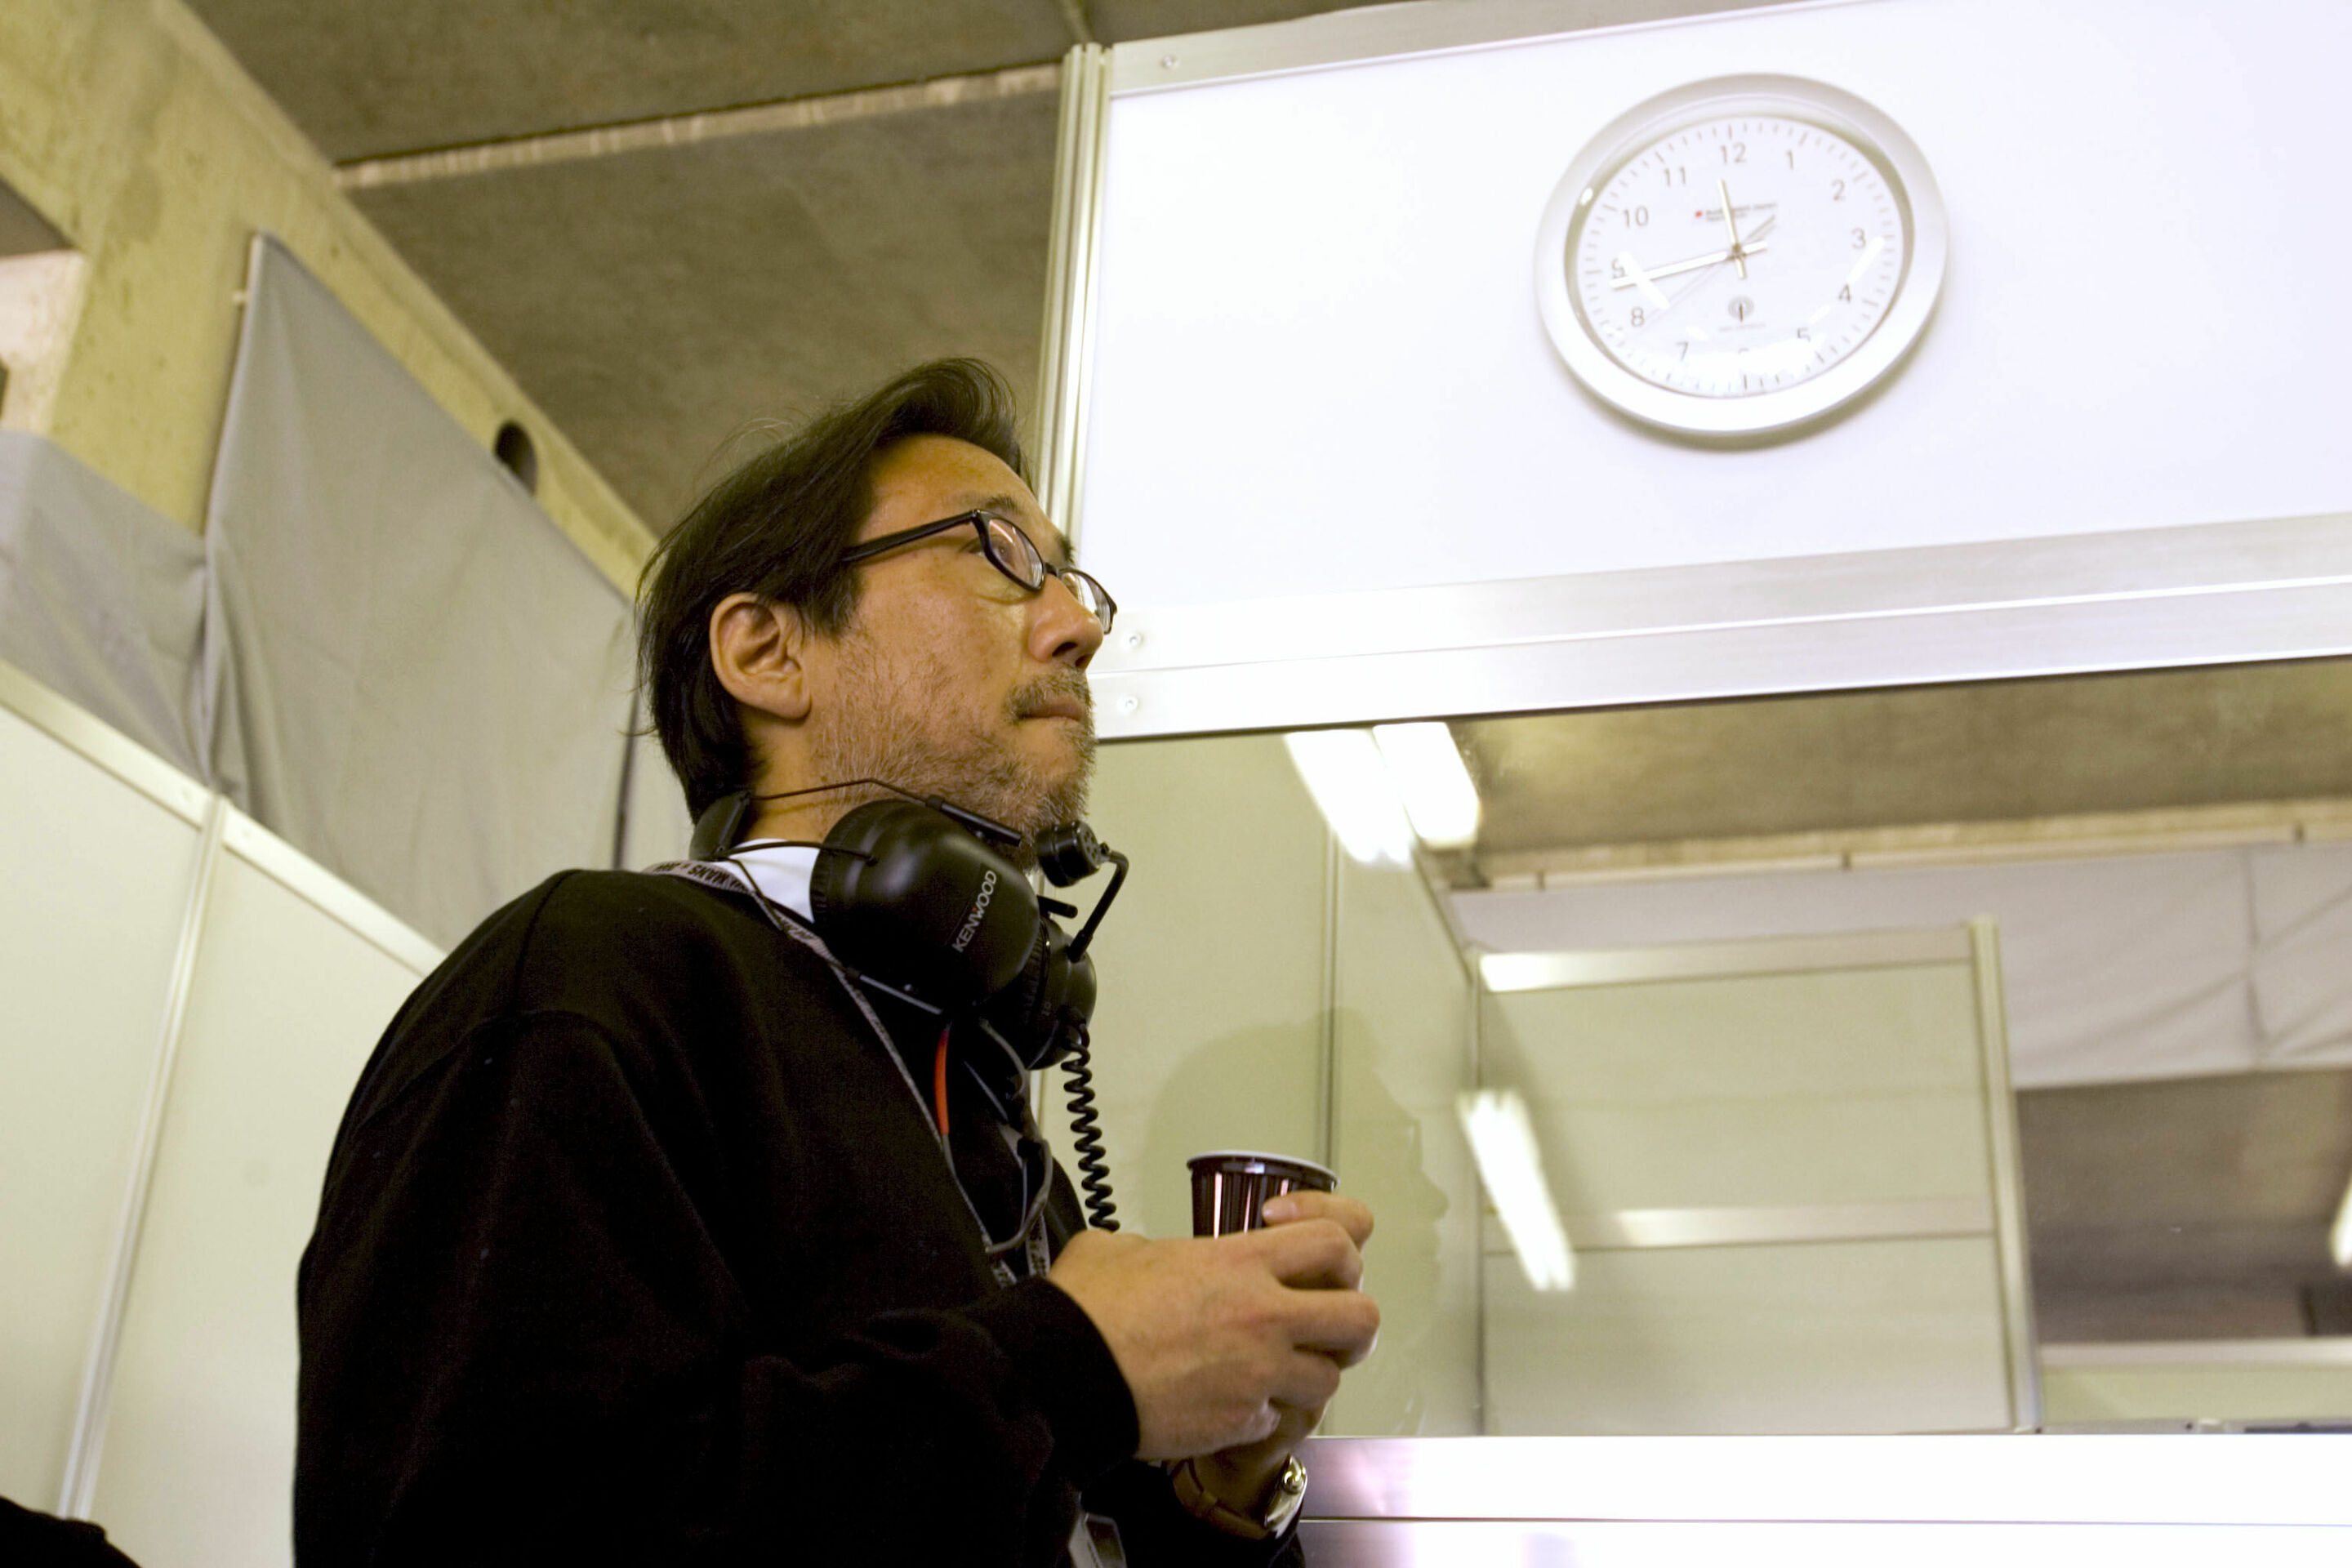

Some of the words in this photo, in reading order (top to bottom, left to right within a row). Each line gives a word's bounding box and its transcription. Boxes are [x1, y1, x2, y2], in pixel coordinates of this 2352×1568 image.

[1721, 142, 1746, 163] 12
[1787, 149, 1794, 170] 1
[1664, 166, 1686, 187] 11
[1832, 179, 1846, 201] 2
[1624, 206, 1649, 229] 10
[1851, 227, 1867, 250] 3
[1838, 283, 1851, 303] 4
[1631, 306, 1645, 327] 8
[1676, 341, 1689, 362] 7
[952, 870, 997, 953] KENWOOD
